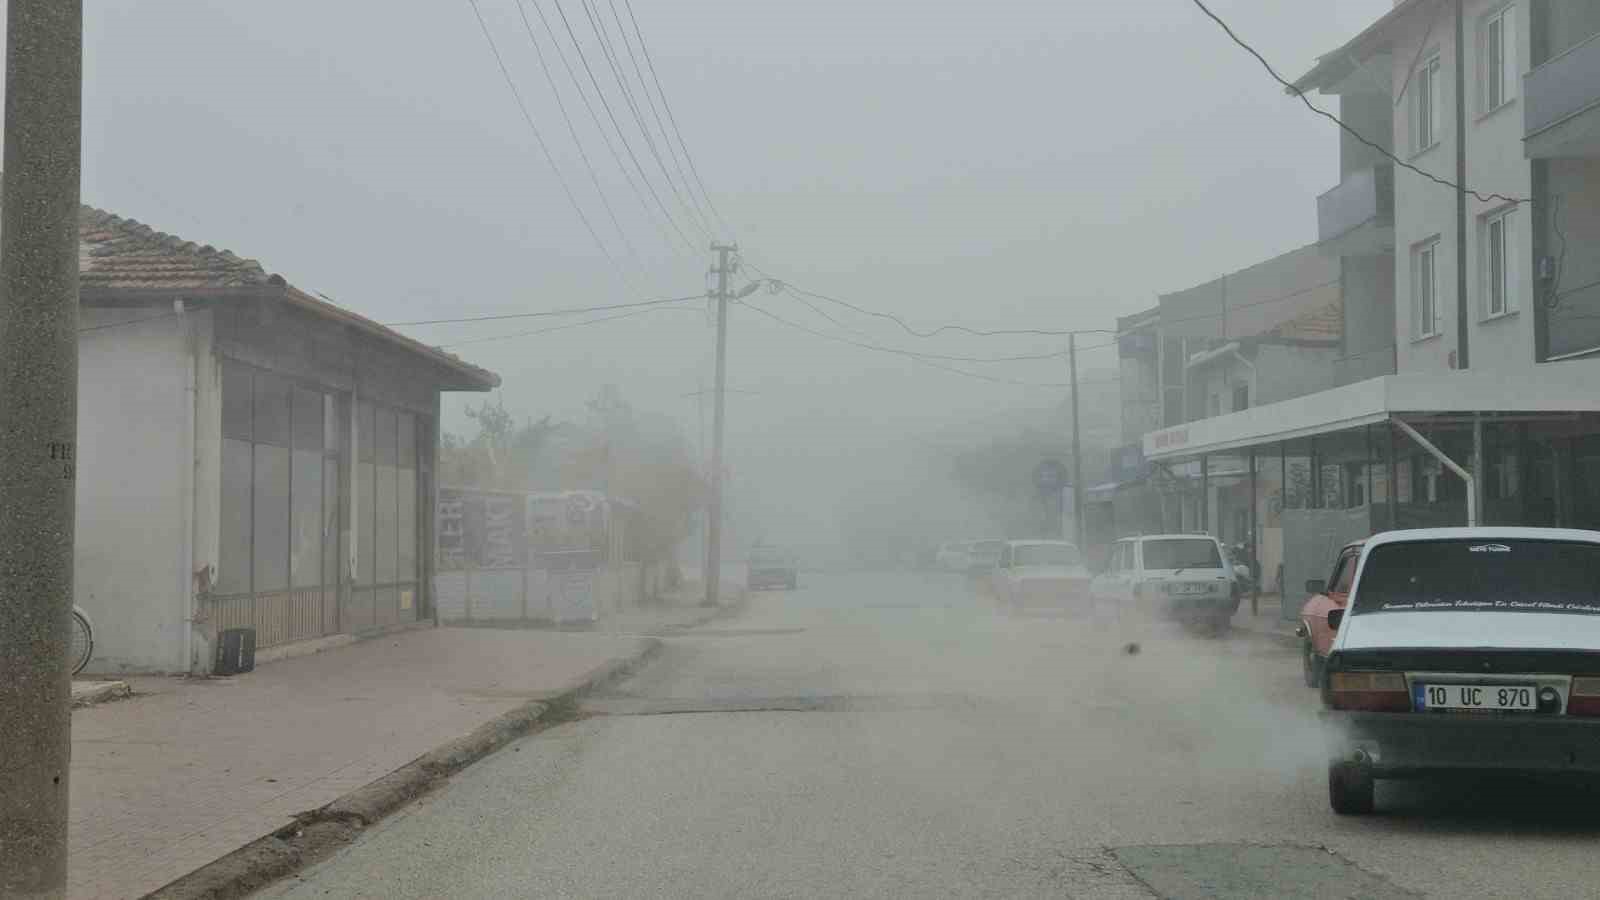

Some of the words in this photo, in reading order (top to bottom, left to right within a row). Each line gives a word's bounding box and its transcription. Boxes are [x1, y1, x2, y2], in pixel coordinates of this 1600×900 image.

[1428, 687, 1447, 705] 10
[1460, 687, 1482, 706] UC
[1497, 688, 1530, 707] 870
